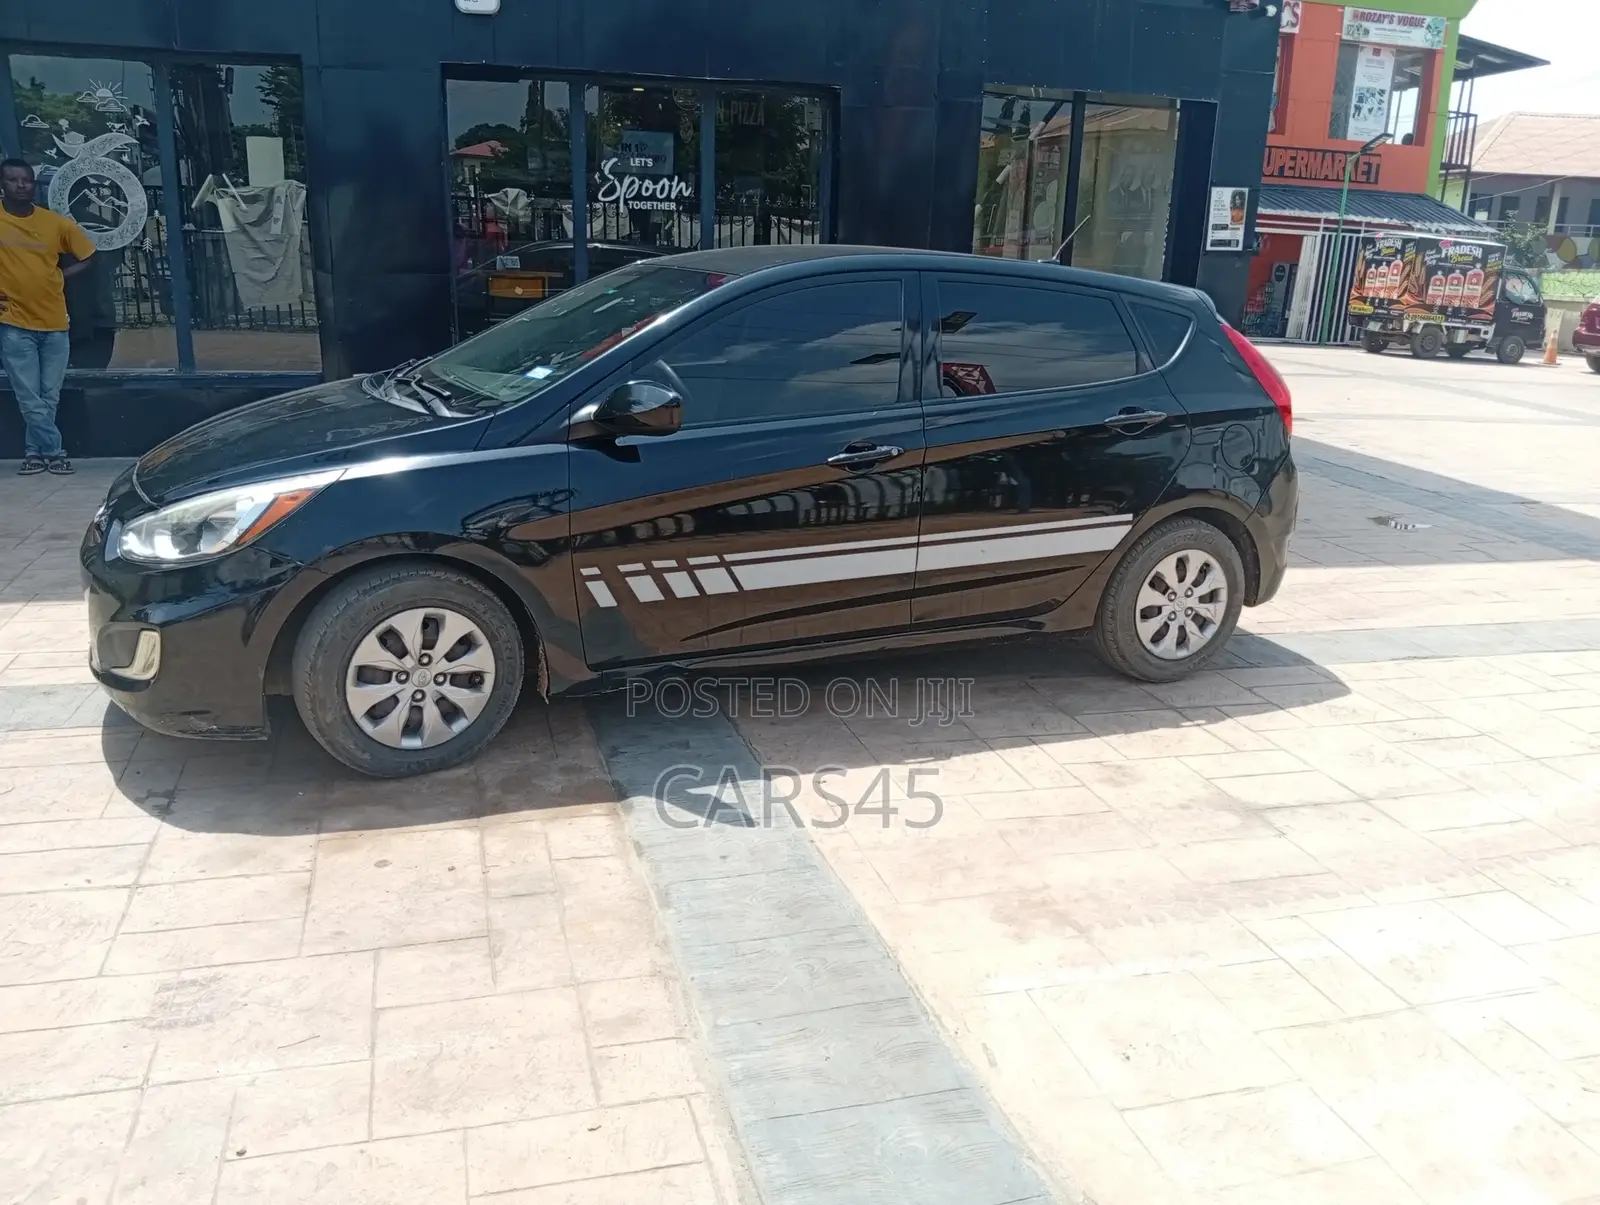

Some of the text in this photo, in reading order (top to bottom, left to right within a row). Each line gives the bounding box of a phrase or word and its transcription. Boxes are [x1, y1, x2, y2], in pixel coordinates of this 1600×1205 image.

[1360, 10, 1427, 28] ROZAY'S VOGUE
[730, 100, 766, 126] PIZZA
[630, 157, 653, 167] LET'S
[1263, 147, 1381, 183] UPERMARKET
[597, 157, 692, 213] Spoon
[628, 201, 677, 211] TOGETHER
[1440, 245, 1483, 259] FRADESH
